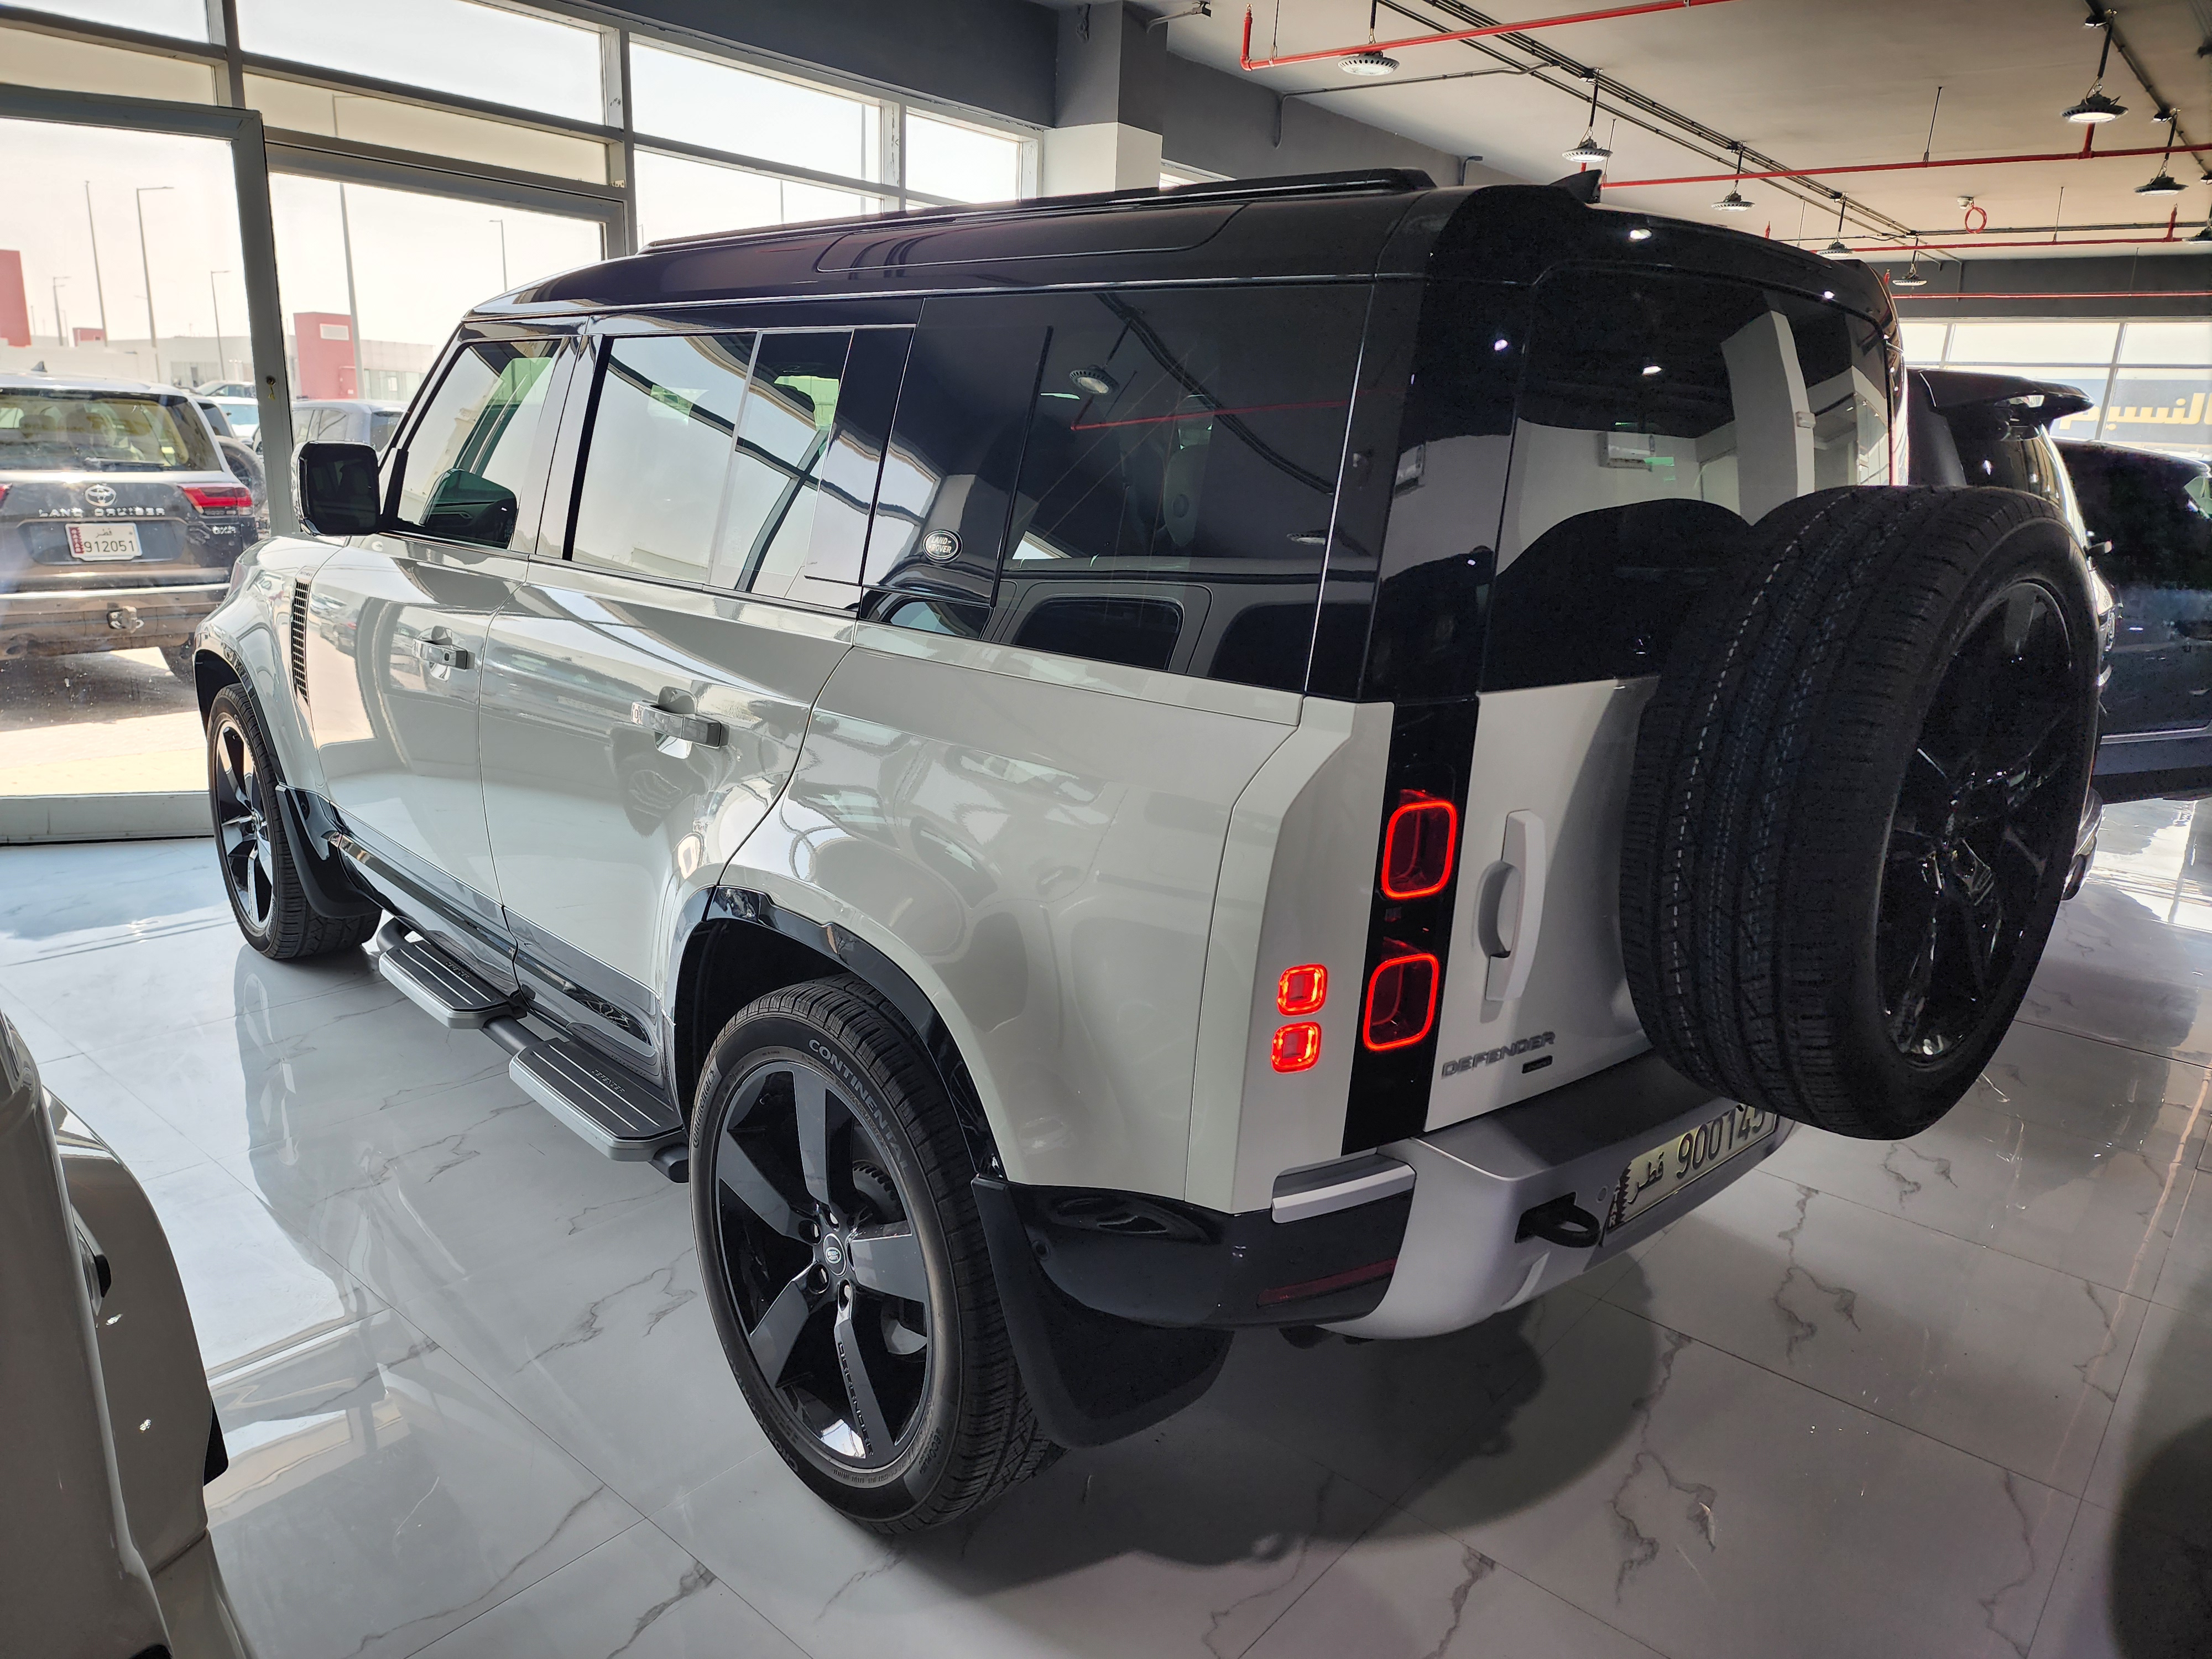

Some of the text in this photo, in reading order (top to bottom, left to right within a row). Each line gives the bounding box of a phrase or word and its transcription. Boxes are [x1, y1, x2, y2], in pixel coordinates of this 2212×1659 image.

[95, 528, 113, 538] قطر
[84, 540, 134, 552] 912051
[931, 536, 948, 545] LAND
[931, 544, 952, 554] ROVER
[1441, 1031, 1556, 1078] DEFENDER
[808, 1039, 909, 1177] CONTINENTAL
[1626, 1151, 1665, 1204] قطر
